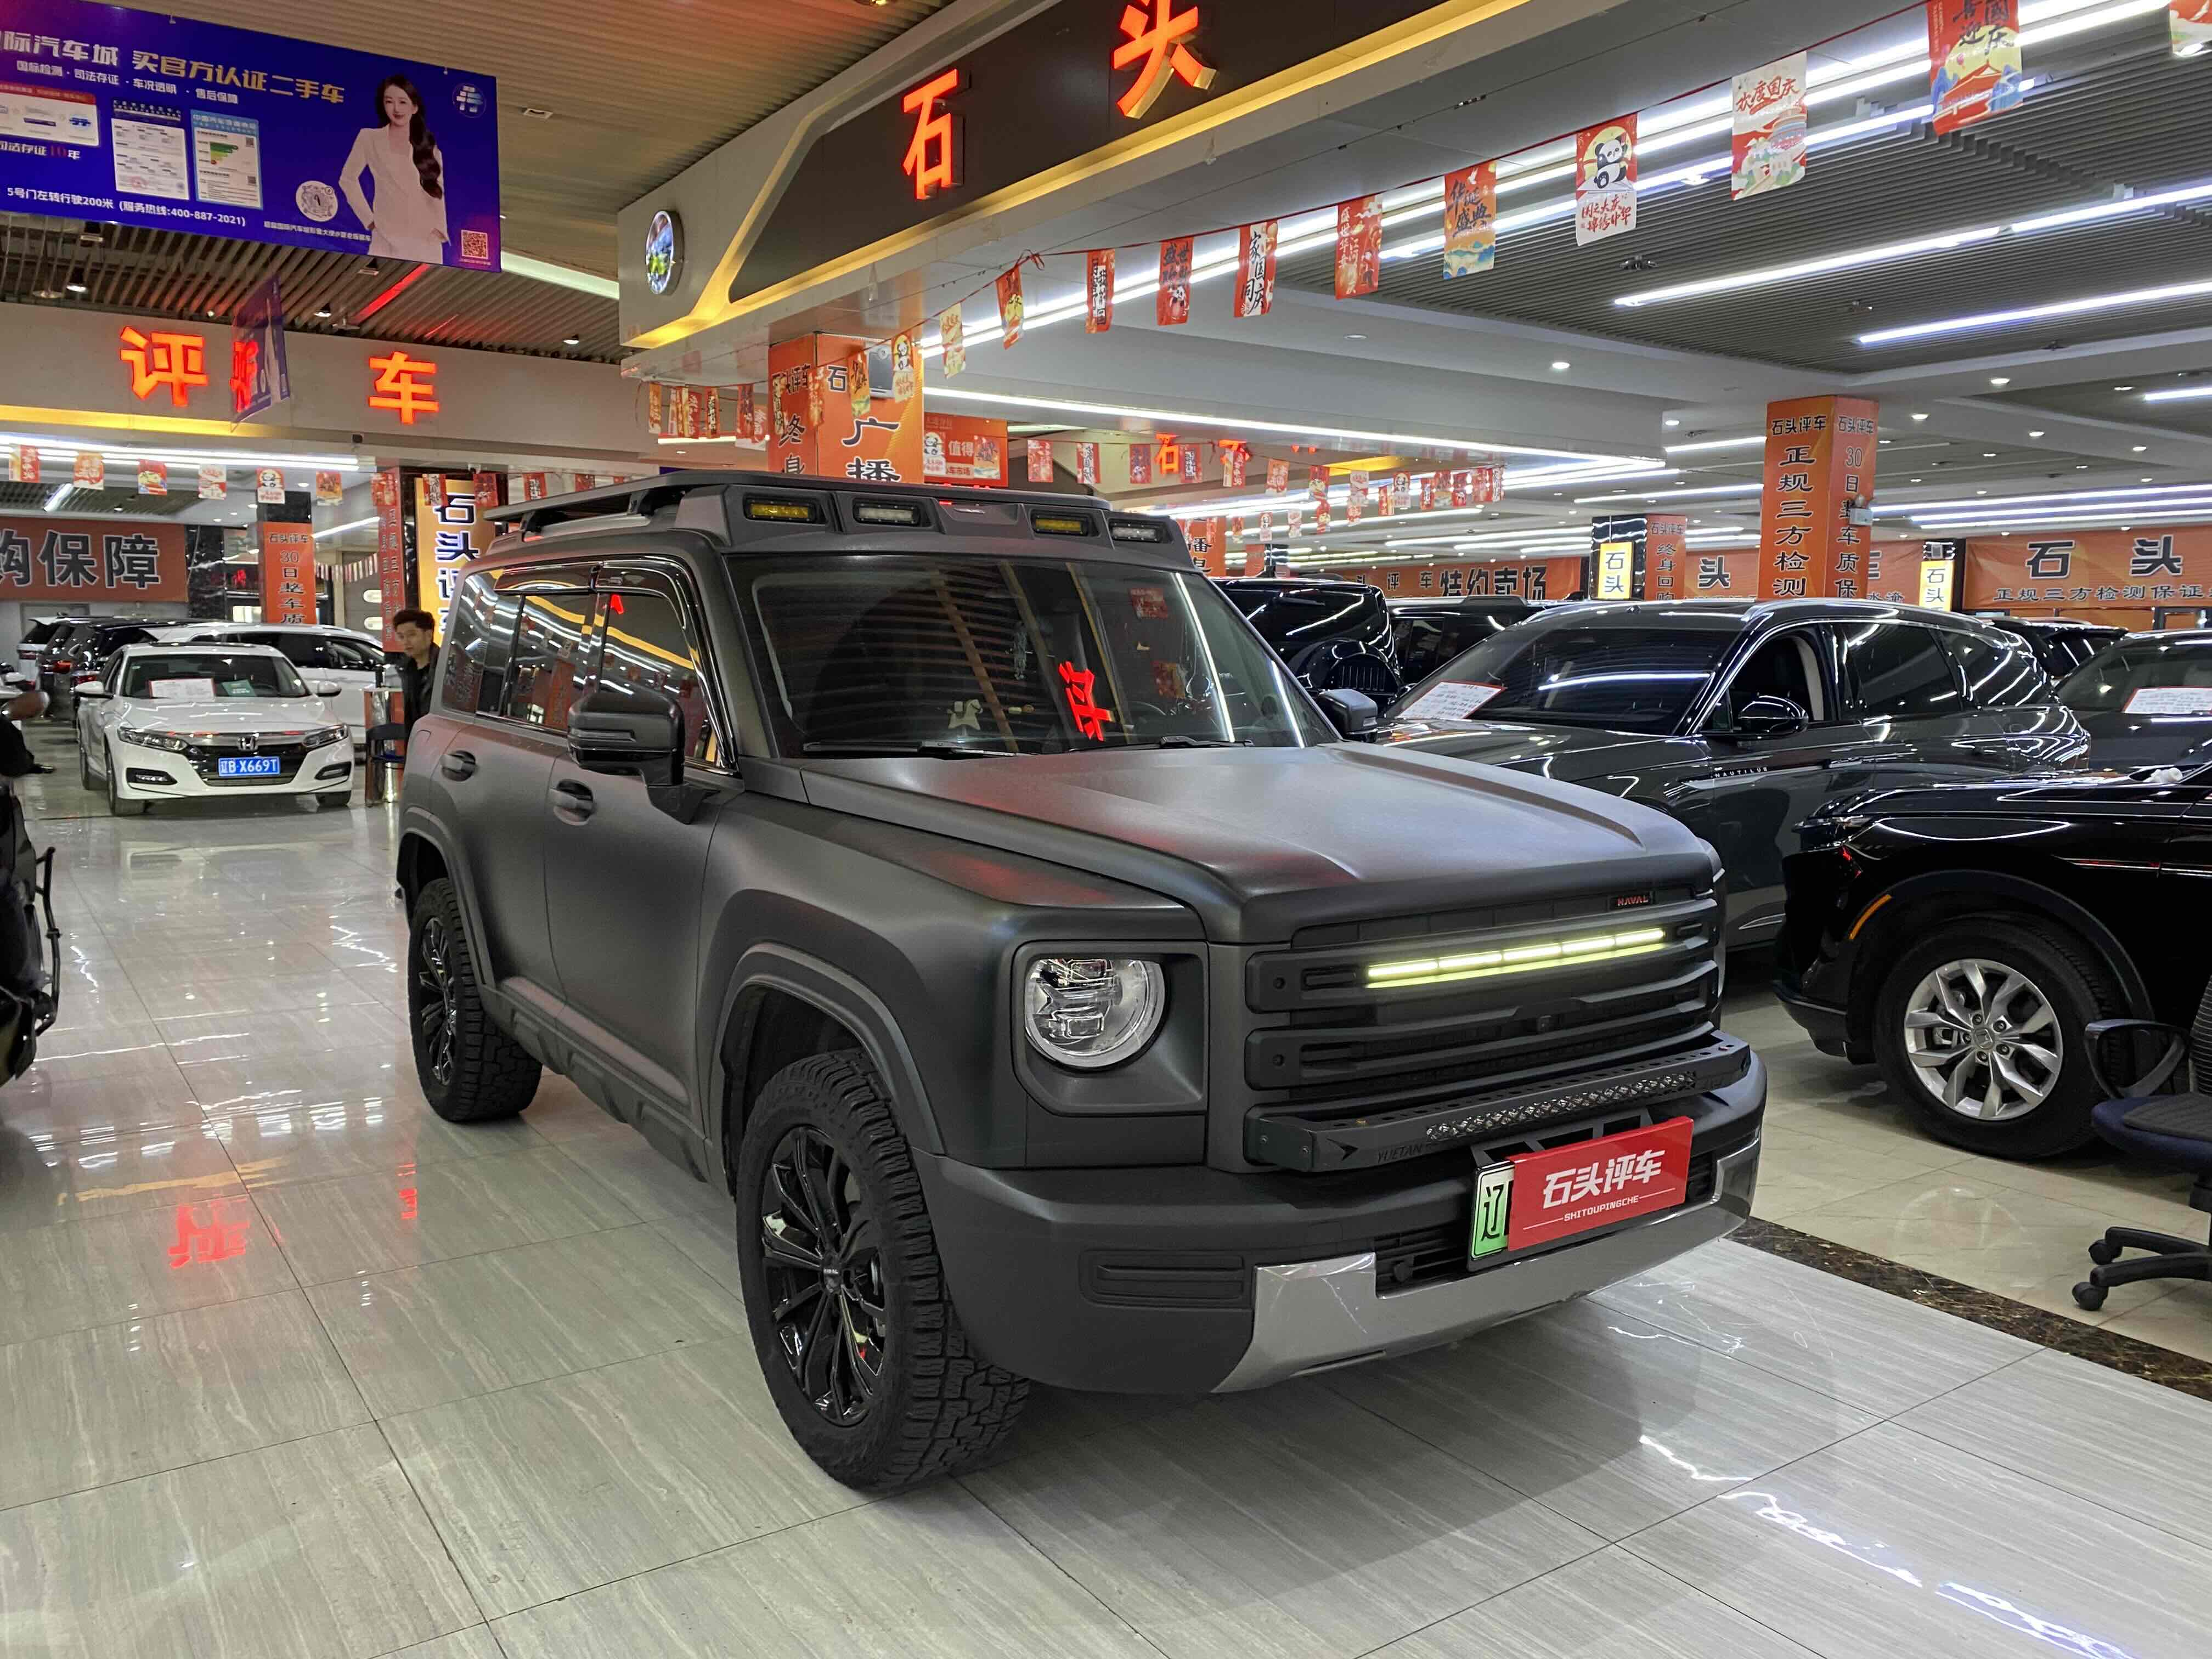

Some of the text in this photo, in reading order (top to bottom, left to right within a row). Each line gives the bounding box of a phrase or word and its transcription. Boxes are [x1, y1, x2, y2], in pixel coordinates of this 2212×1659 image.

[132, 49, 346, 104] 买官方认证二手车
[1737, 75, 1800, 111] 欢度国庆
[903, 0, 1216, 200] 石 头
[120, 326, 208, 408] 评
[368, 351, 440, 425] 车
[1771, 415, 1826, 436] 石头评车
[1838, 416, 1874, 435] 石头评车
[840, 417, 901, 482] 广播
[1773, 445, 1816, 597] 正规三方检测
[1605, 551, 1626, 593] 石头
[1699, 556, 1730, 589] 头
[2027, 535, 2183, 579] 石 头
[1714, 766, 1768, 778] NAUTILUS
[1543, 1149, 1665, 1209] 石头评车
[1564, 1195, 1639, 1222] SHITOUPINGCHE
